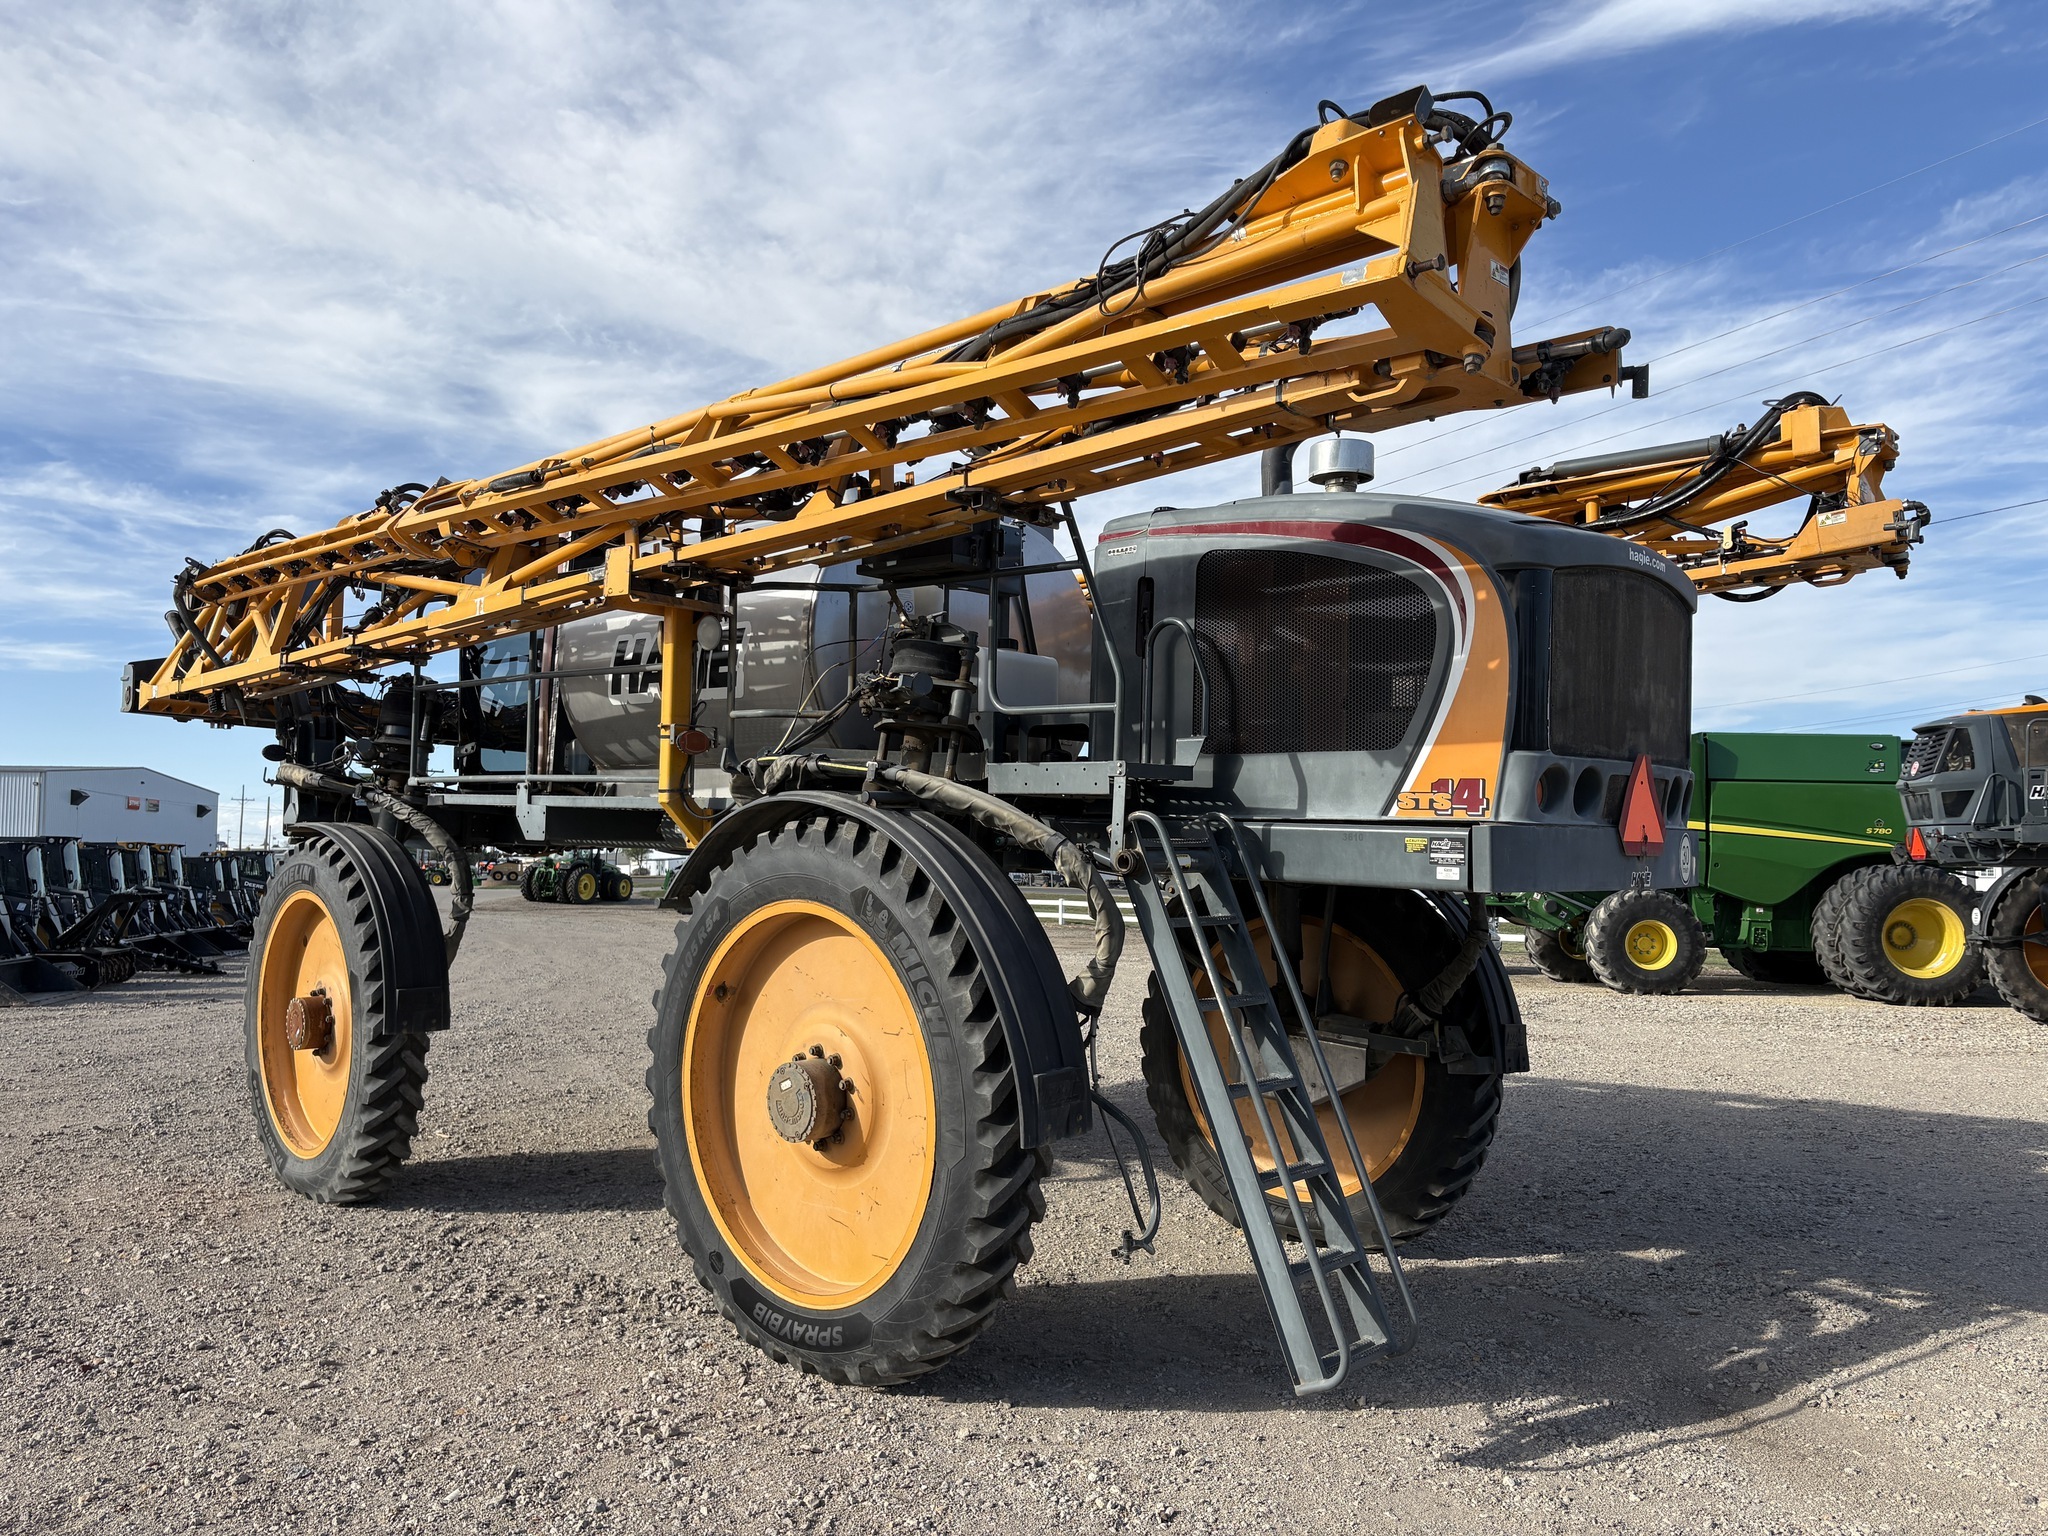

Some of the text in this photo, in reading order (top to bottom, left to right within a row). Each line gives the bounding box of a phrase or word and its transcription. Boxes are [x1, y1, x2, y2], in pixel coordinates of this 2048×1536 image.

[1629, 547, 1666, 572] hagie.com
[1397, 778, 1490, 817] STS 14
[1342, 832, 1364, 842] 3610
[244, 881, 265, 889] DEERE
[752, 1302, 843, 1347] SPRAYBIB
